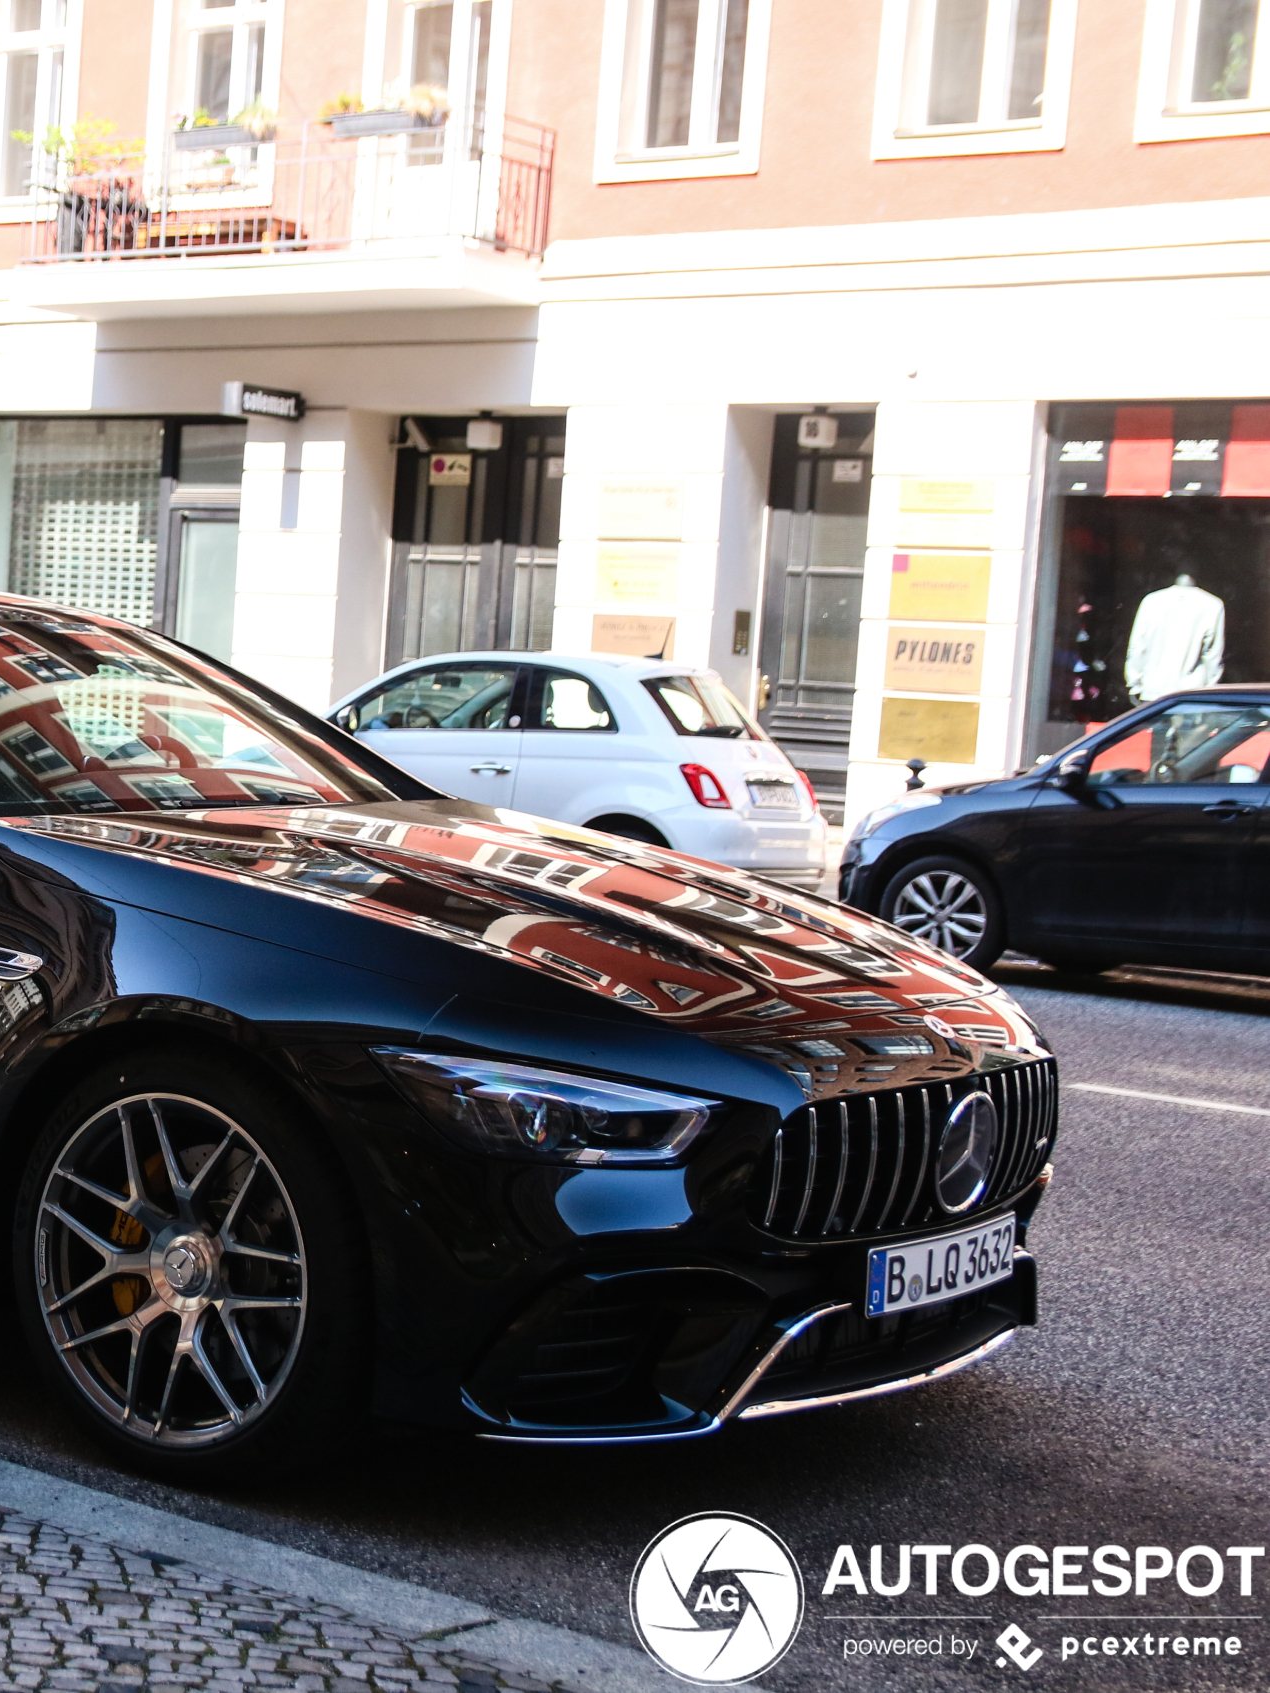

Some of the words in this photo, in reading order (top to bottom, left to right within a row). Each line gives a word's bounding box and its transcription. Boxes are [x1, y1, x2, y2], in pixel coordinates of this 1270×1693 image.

[894, 640, 976, 664] PYLONES
[872, 1290, 880, 1304] D
[887, 1254, 906, 1304] B
[926, 1242, 961, 1295] LQ
[964, 1224, 1013, 1284] 3632
